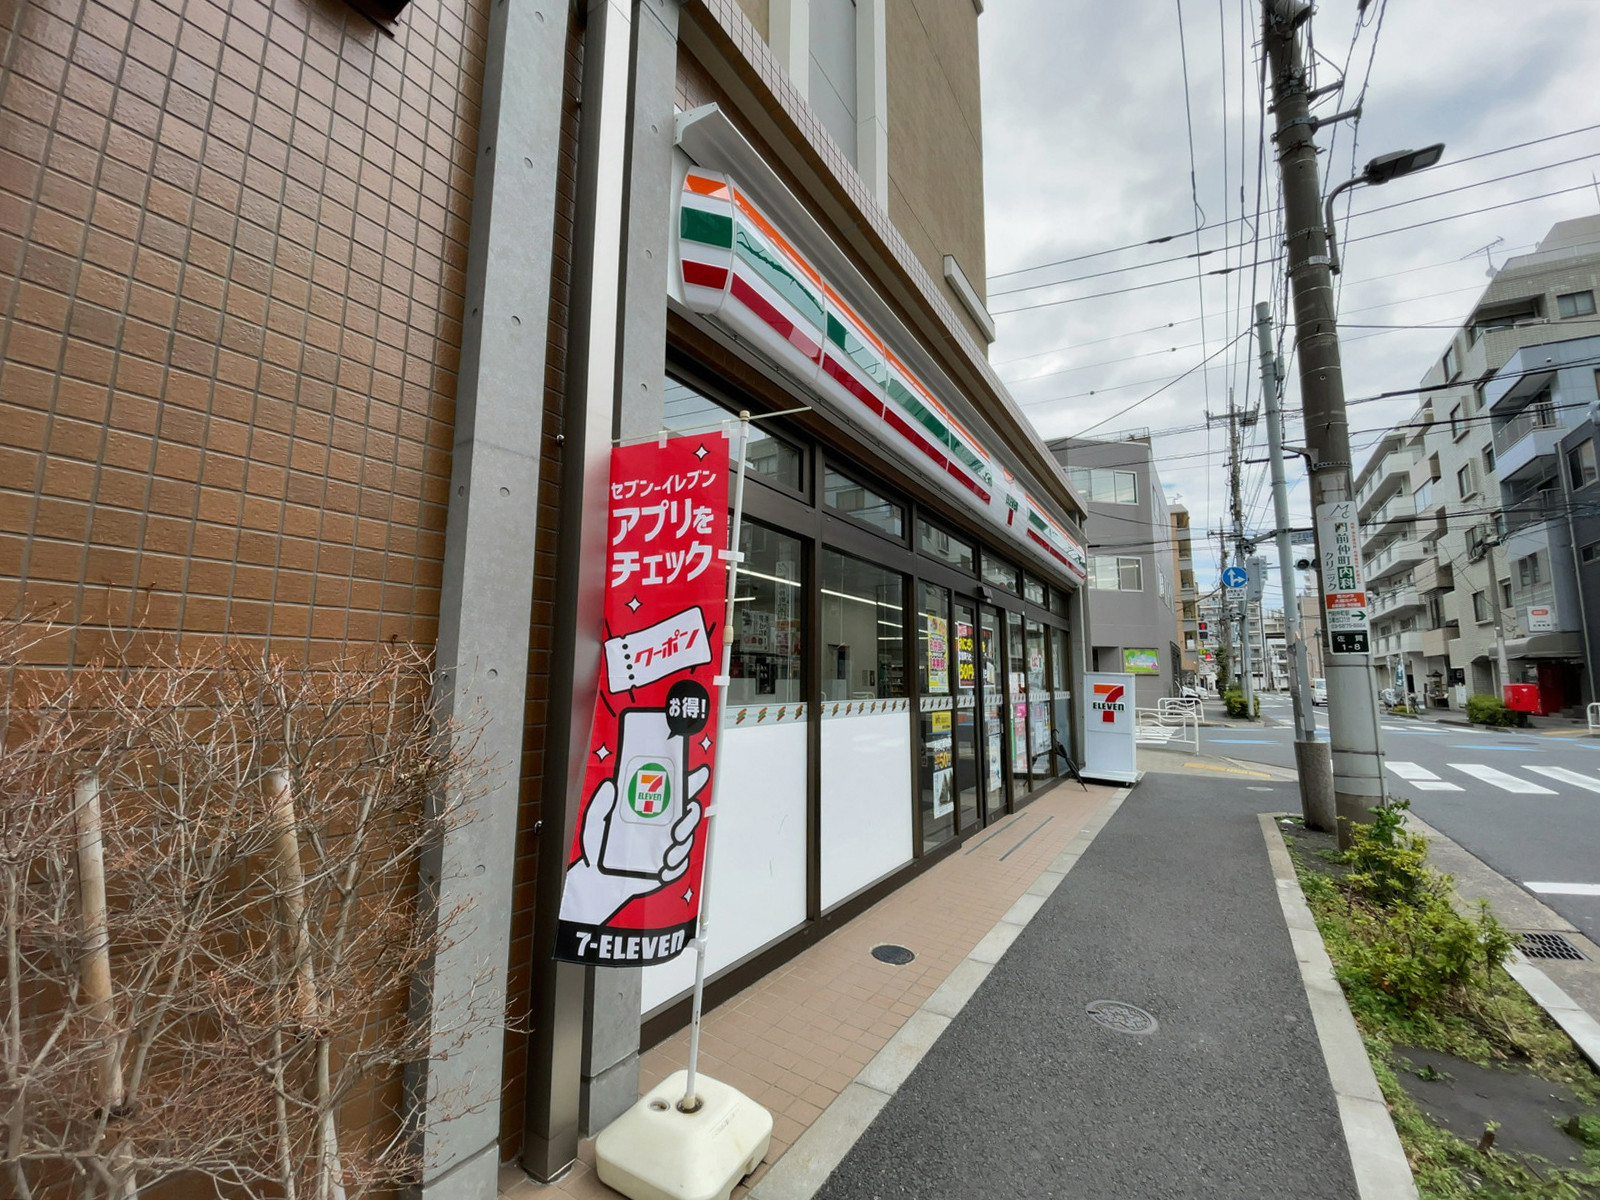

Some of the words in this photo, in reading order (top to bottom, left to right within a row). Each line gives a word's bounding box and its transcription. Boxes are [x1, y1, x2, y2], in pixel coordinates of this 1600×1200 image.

[612, 498, 715, 547] アプリを
[611, 541, 713, 588] チェック
[1324, 552, 1337, 592] クリニック
[634, 628, 700, 667] クーポン
[669, 697, 706, 719] お得!
